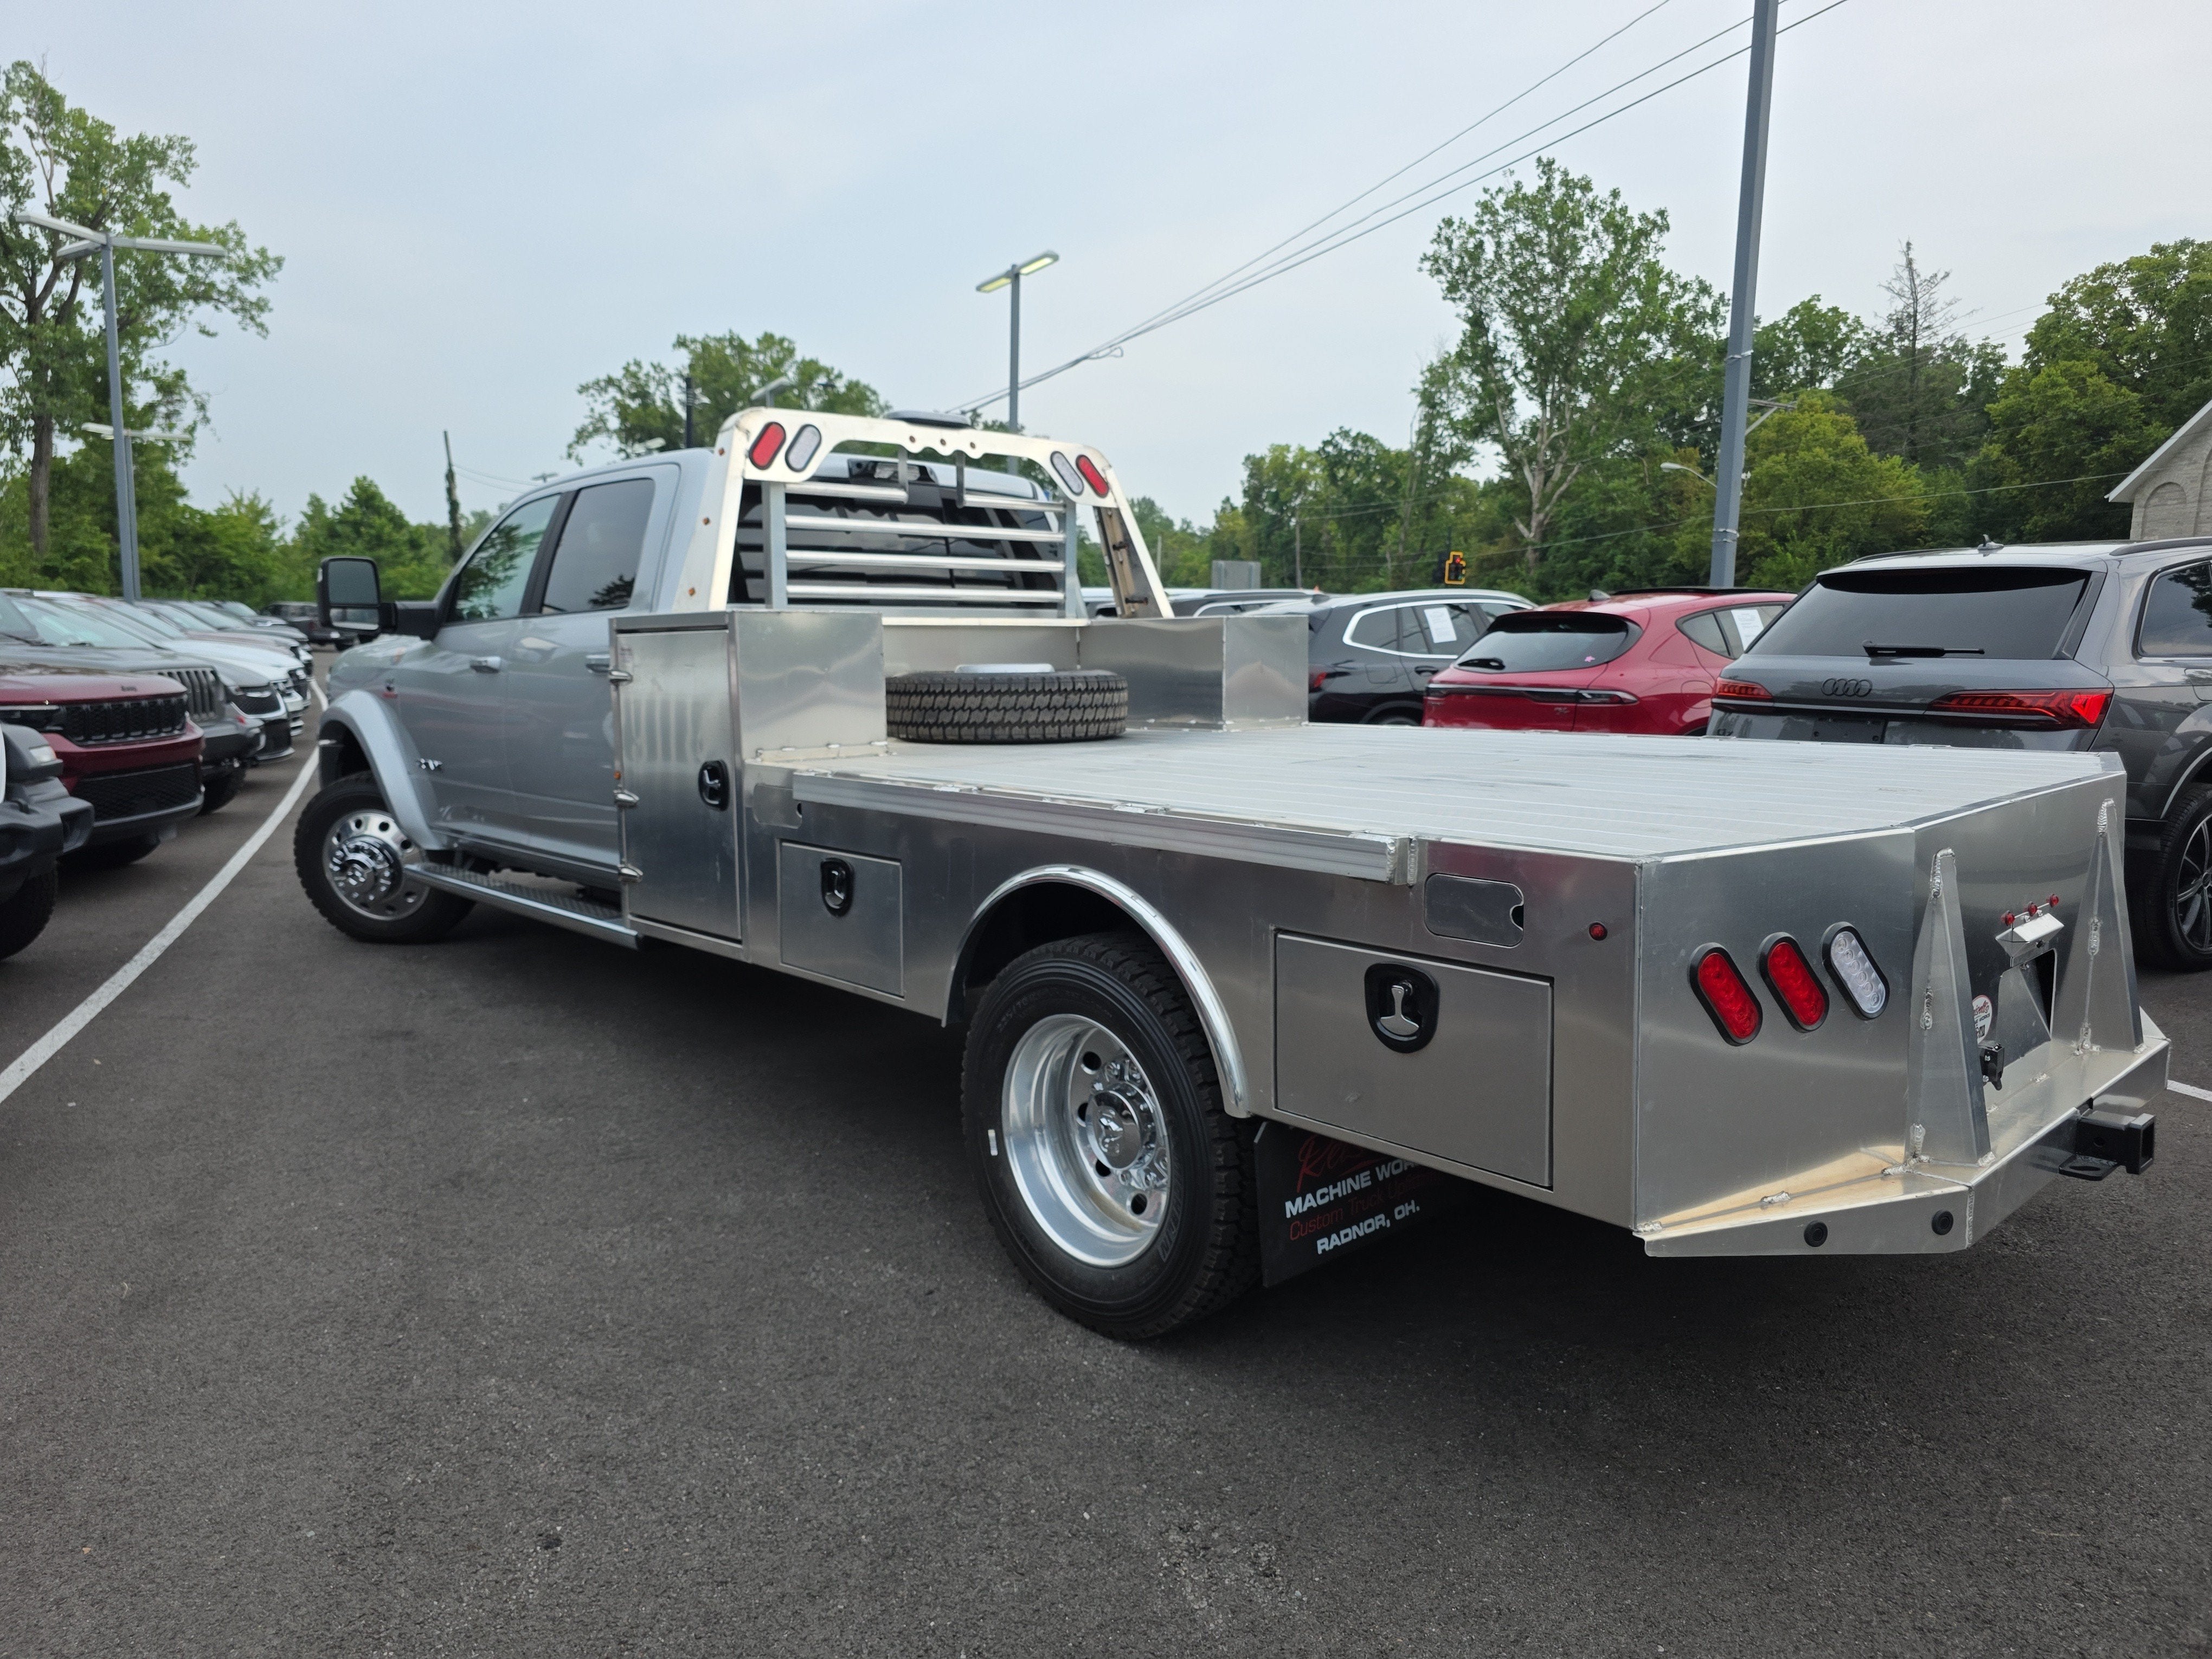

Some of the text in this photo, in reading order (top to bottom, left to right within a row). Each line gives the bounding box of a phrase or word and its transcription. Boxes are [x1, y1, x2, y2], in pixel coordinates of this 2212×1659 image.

[1284, 1171, 1372, 1219] MACHINE
[1289, 1188, 1384, 1241] Custom Truck
[1316, 1199, 1420, 1255] RADNOR, OH.
